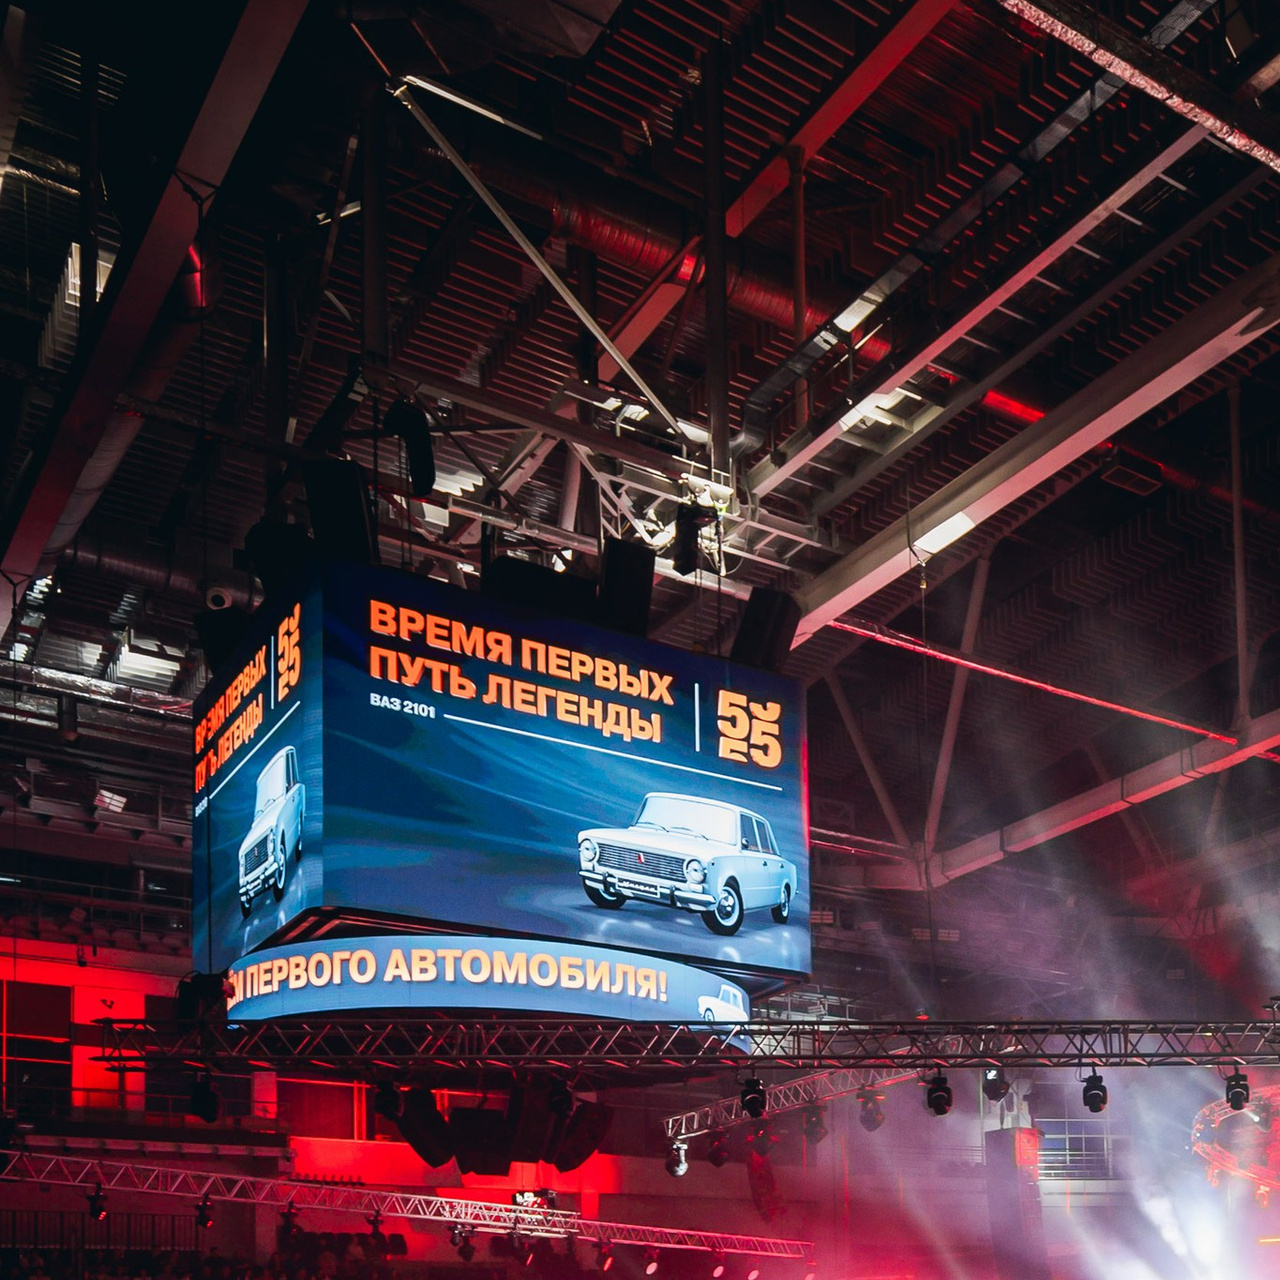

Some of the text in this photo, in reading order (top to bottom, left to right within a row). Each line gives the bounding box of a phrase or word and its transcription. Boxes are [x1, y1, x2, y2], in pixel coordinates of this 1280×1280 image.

[225, 644, 267, 718] ПЕРВЫХ
[370, 599, 675, 706] ВРЕМЯ ПЕРВЫХ
[216, 692, 263, 768] ЛЕГЕНДЫ
[370, 645, 663, 743] ПУТЬ ЛЕГЕНДЫ
[370, 692, 437, 719] ВАЗ 2101
[246, 949, 376, 998] ПЕРВОГО
[388, 949, 667, 1001] АВТОМОБИЛЯ!
